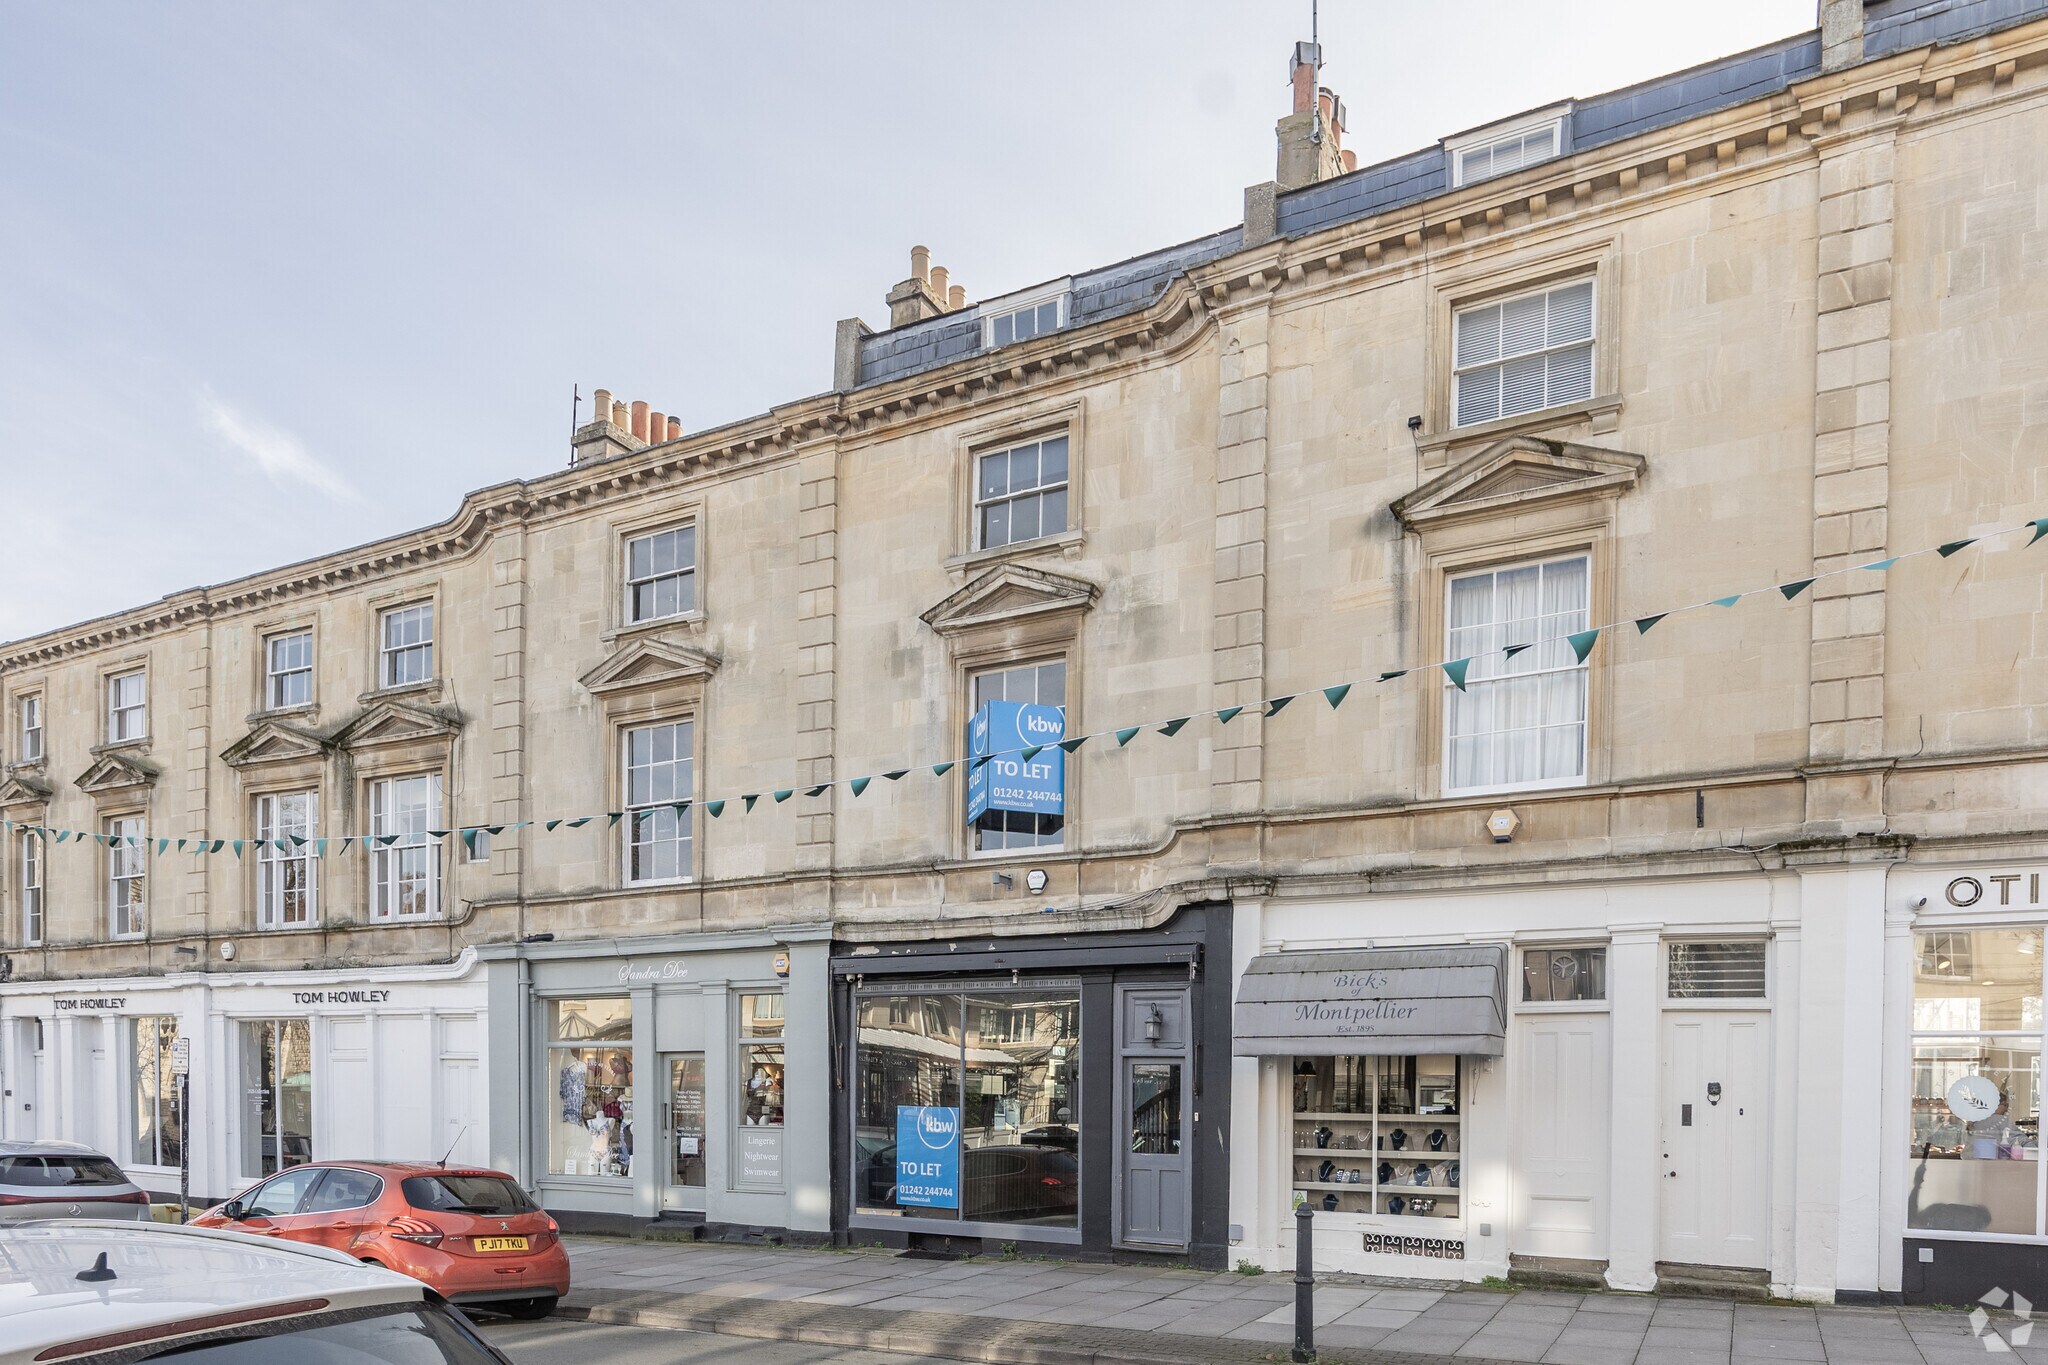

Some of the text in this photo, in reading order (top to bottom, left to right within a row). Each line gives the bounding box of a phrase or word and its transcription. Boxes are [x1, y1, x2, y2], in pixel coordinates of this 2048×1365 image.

[1027, 715, 1062, 734] kbw
[994, 760, 1052, 779] TO LET
[993, 787, 1062, 802] 01242 244744
[1945, 873, 2039, 908] OTI
[618, 960, 688, 983] Sandra Dee
[291, 990, 389, 1004] TOM HOWLEY
[1350, 988, 1362, 997] of
[54, 998, 126, 1009] TOM HOWLEY
[1295, 1000, 1418, 1023] Montpellier
[926, 1116, 953, 1133] kbw
[748, 1136, 775, 1147] Lingerie
[744, 1151, 779, 1162] Nightwear
[744, 1167, 780, 1176] Swimwear
[900, 1162, 942, 1177] TO LET
[900, 1185, 953, 1197] 01242 244744
[480, 1239, 523, 1249] PJ17 TKU
